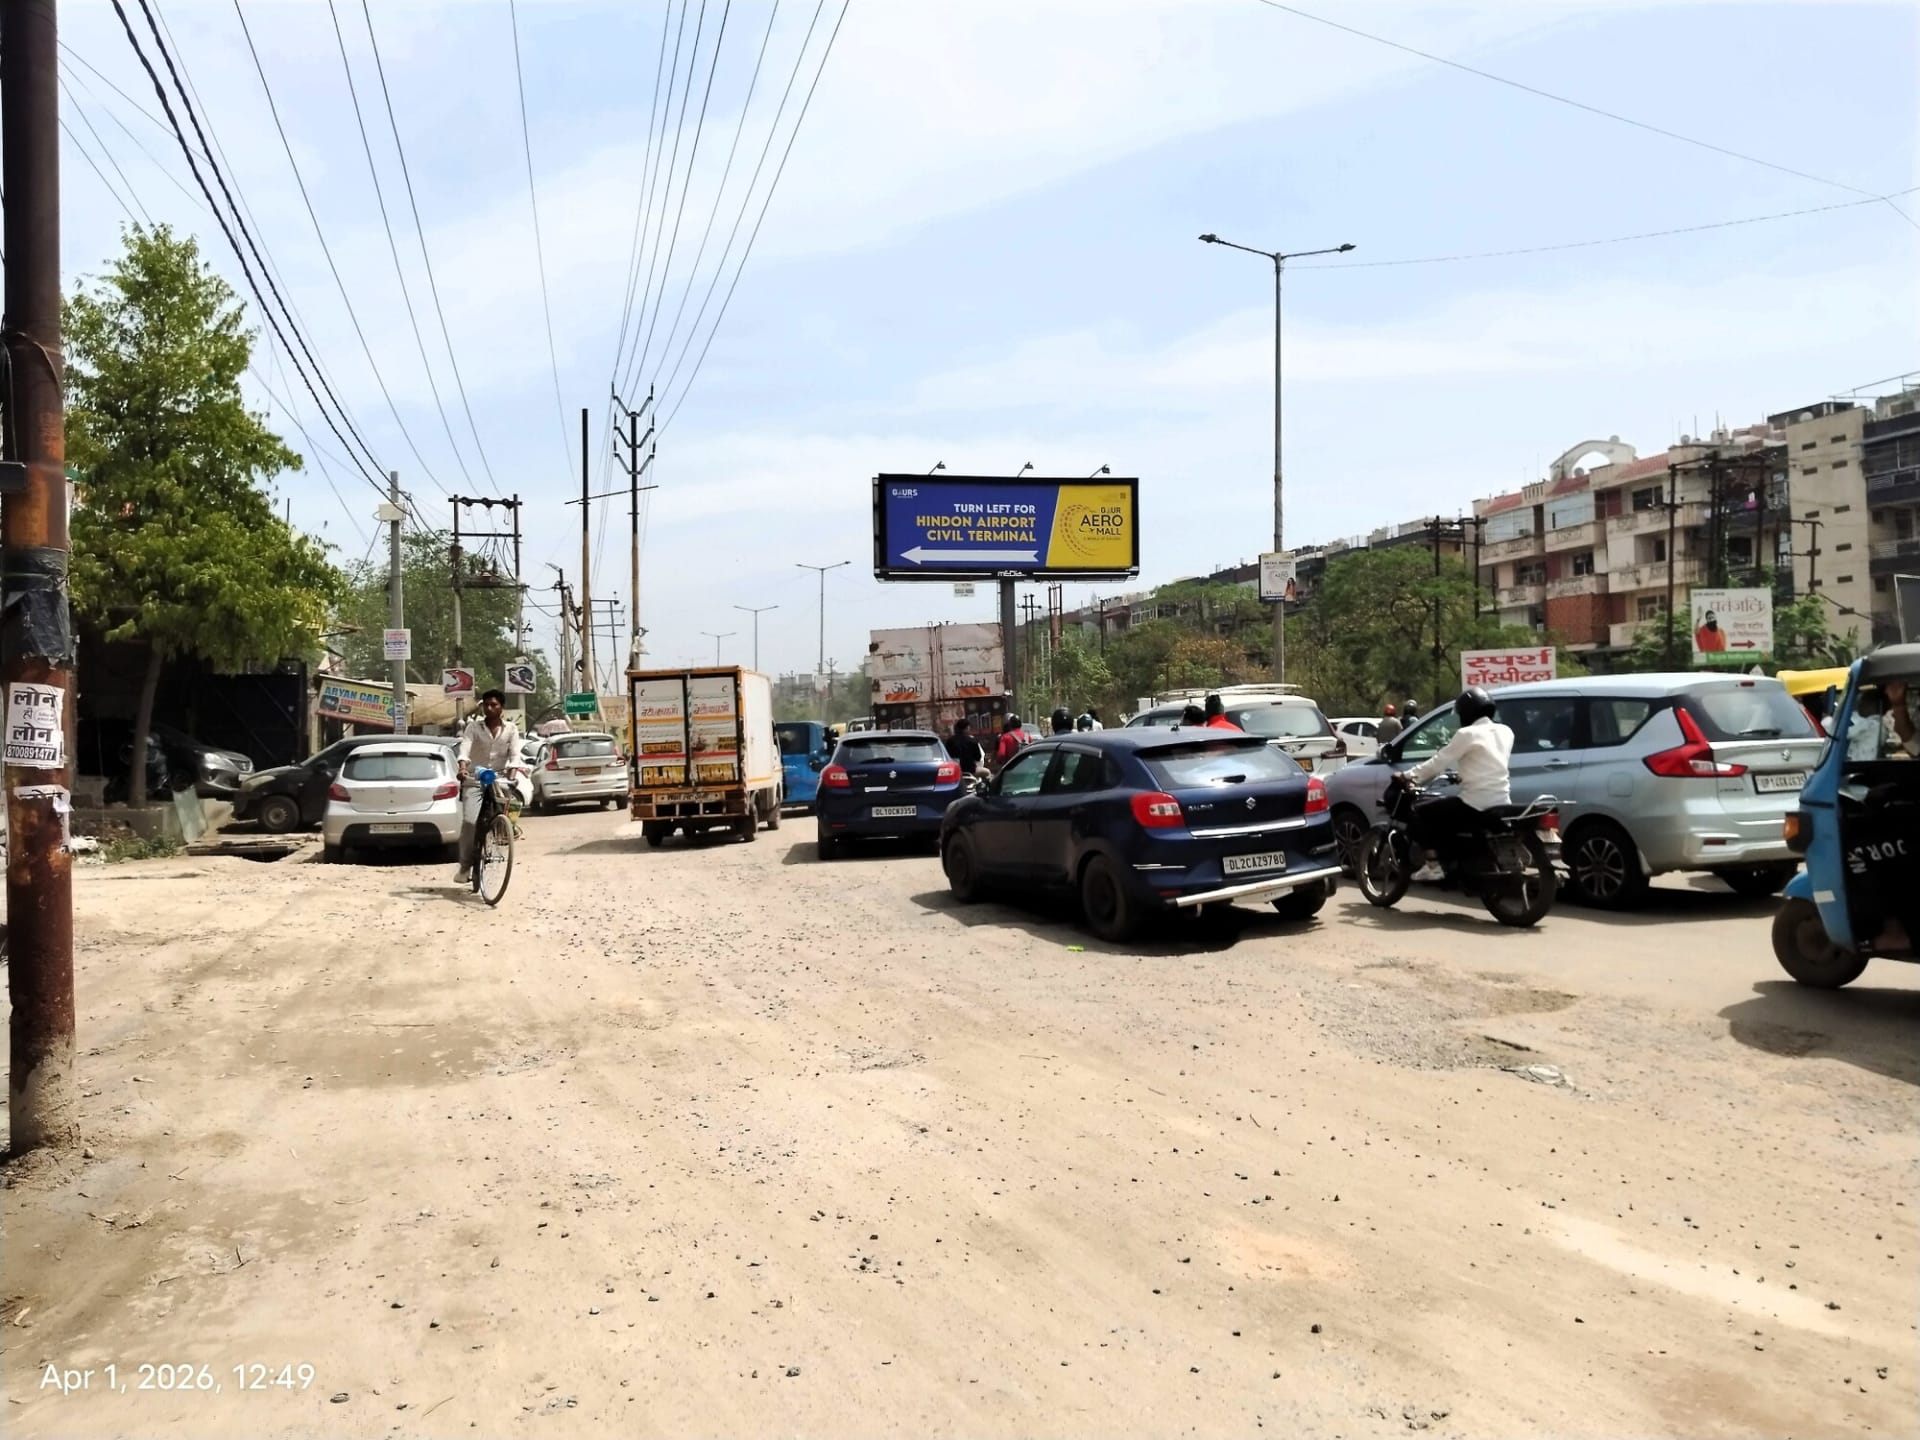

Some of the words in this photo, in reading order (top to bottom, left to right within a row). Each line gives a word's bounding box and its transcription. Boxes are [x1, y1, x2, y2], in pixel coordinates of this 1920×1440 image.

[954, 503, 983, 513] TURN
[987, 504, 1011, 513] LEFT
[1014, 504, 1036, 514] FOR
[916, 515, 972, 527] HINDON
[976, 516, 1036, 528] AIRPORT
[1081, 514, 1123, 527] AERO
[927, 530, 964, 541] CIVIL
[967, 530, 1036, 542] TERMINAL
[1096, 528, 1121, 536] MALL
[1466, 649, 1552, 668] स्पर्श
[14, 687, 58, 708] लोन
[325, 686, 357, 698] ARYAN
[360, 692, 380, 702] CAR
[13, 722, 53, 742] लोन
[7, 745, 54, 759] 8700891477
